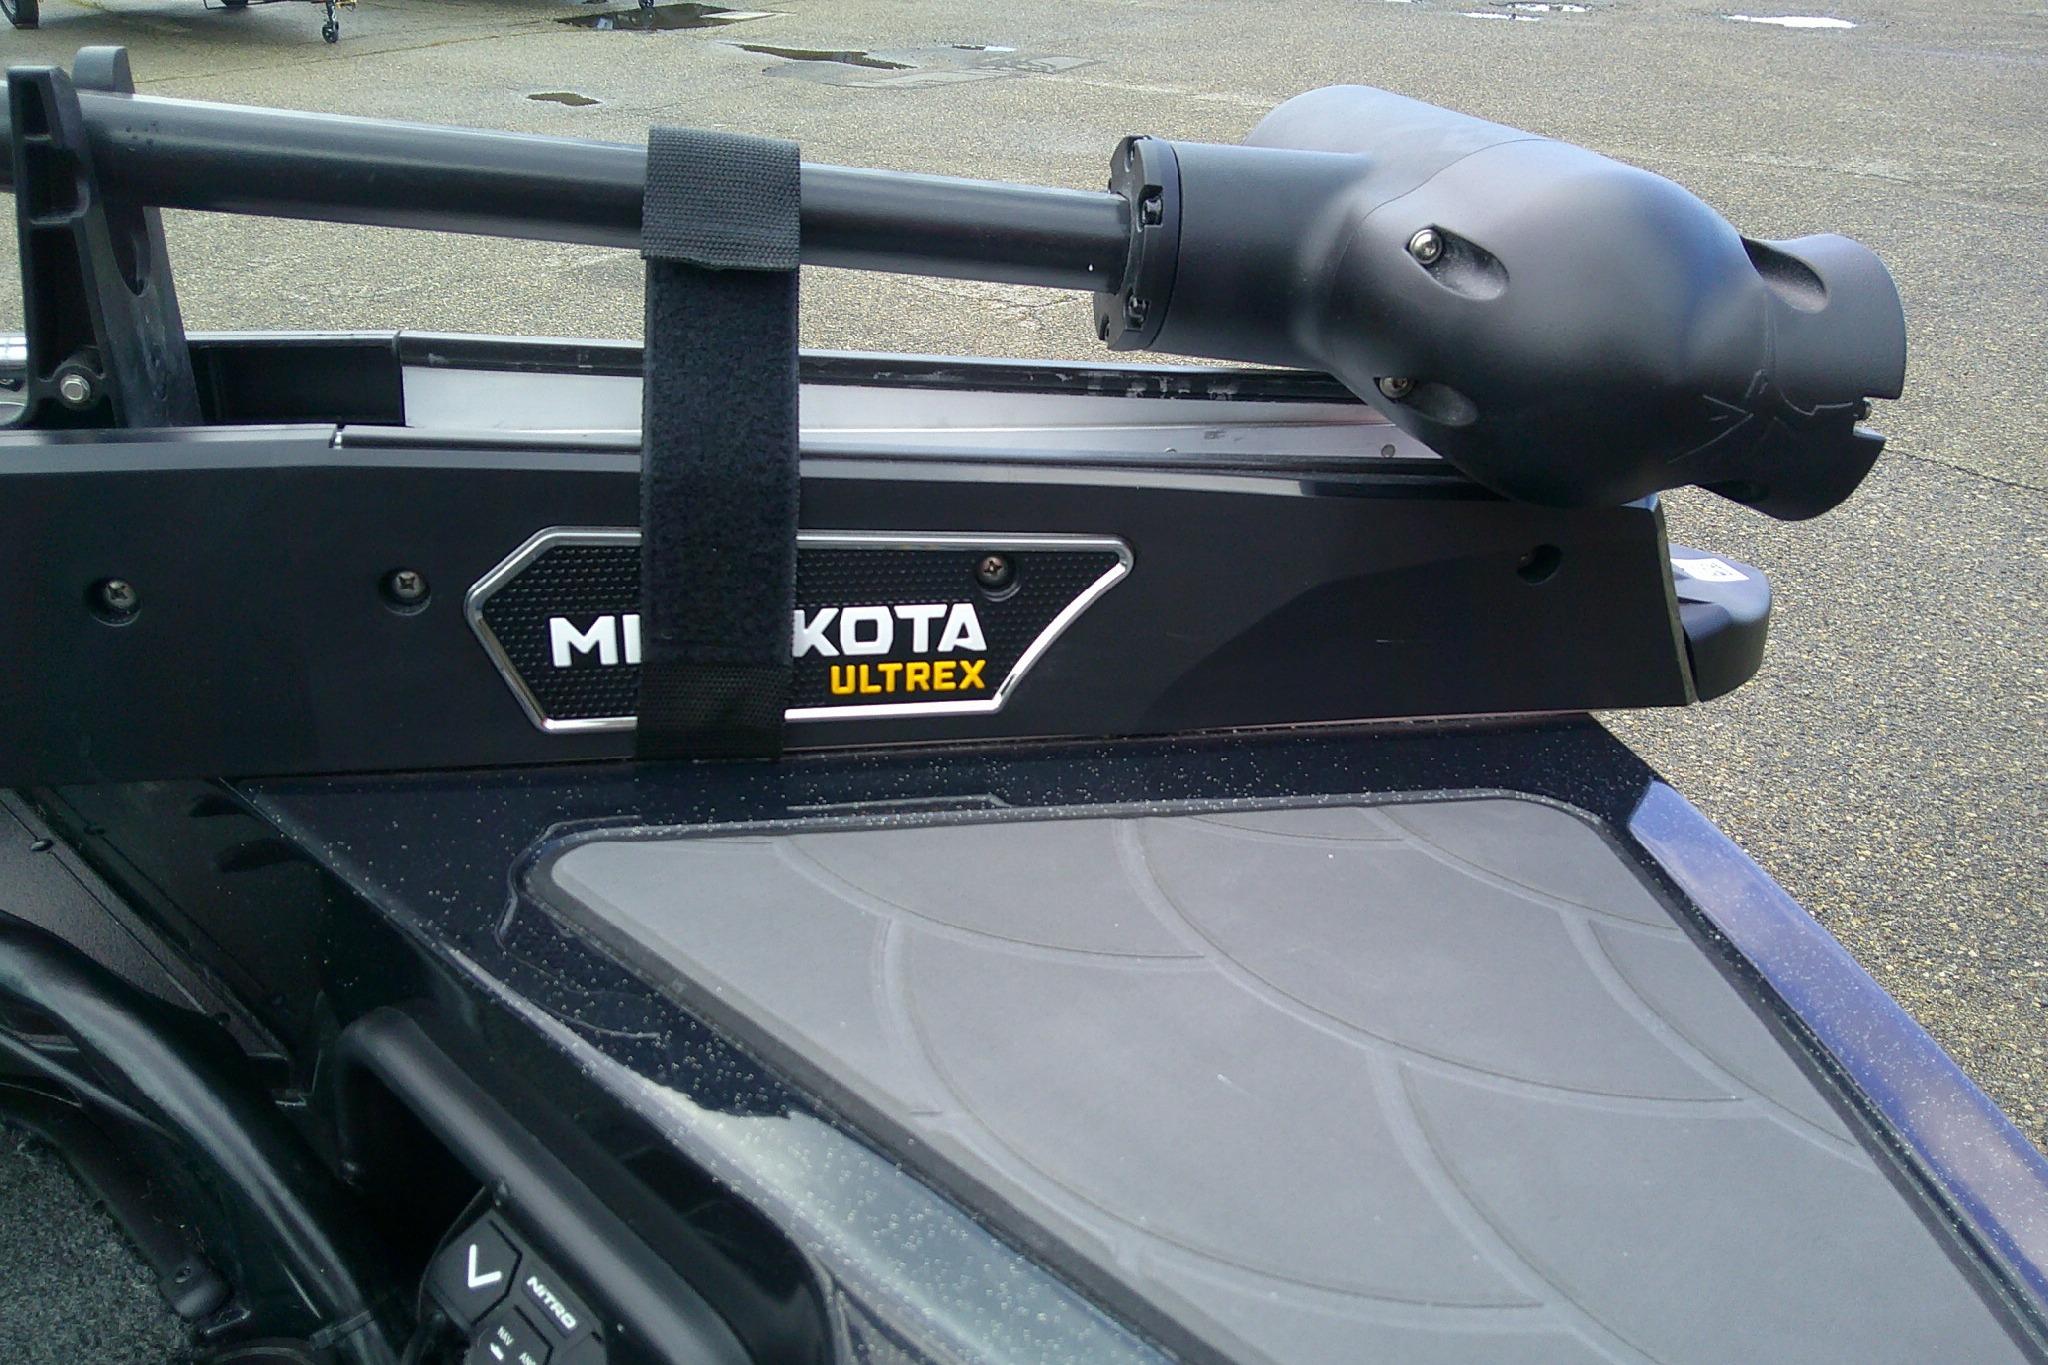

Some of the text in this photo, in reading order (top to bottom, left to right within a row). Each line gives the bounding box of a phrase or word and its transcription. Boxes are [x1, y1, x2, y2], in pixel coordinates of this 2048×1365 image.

[549, 602, 988, 668] MI KOTA
[830, 659, 986, 695] ULTREX
[527, 1276, 577, 1330] NITRO
